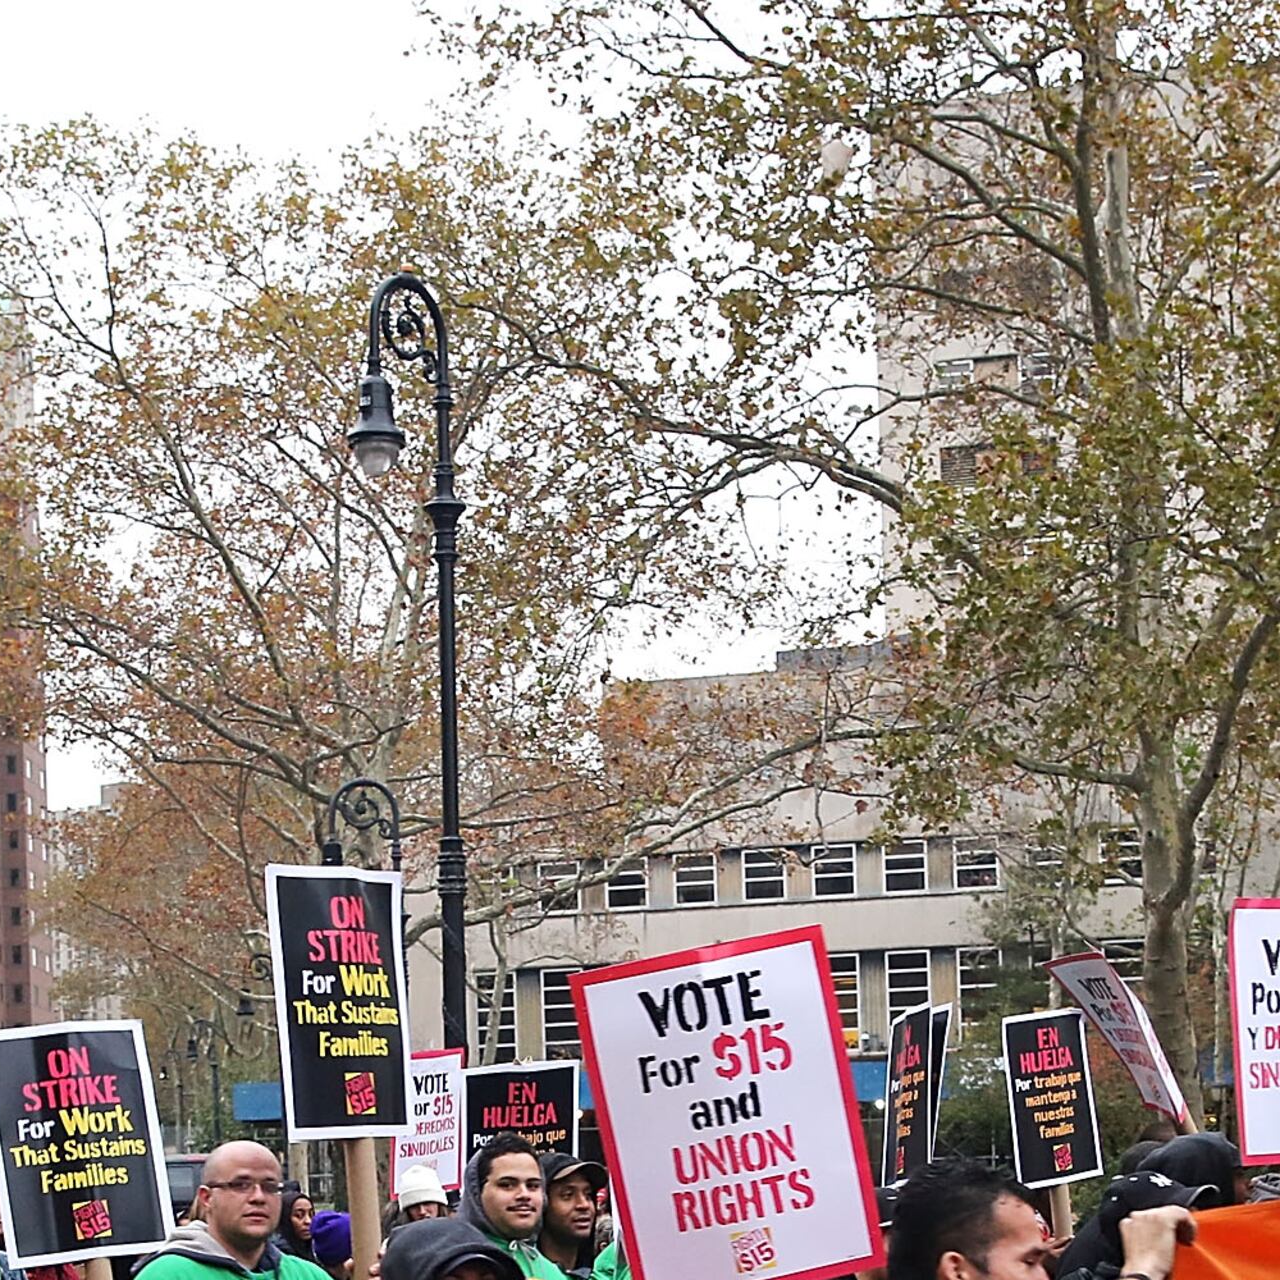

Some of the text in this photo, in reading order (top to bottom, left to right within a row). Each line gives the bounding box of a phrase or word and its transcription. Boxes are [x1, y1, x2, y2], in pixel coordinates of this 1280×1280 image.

[330, 896, 365, 929] ON
[307, 930, 383, 965] STRIKE
[302, 965, 391, 998] For Work
[293, 1000, 399, 1025] That Sustains
[638, 970, 770, 1038] VOTE
[319, 1031, 388, 1057] Families
[1037, 1027, 1059, 1050] EN
[1247, 1027, 1258, 1050] Y
[47, 1046, 90, 1079] ON
[638, 1022, 791, 1093] For $15
[1020, 1046, 1074, 1074] HUELGA
[22, 1075, 121, 1112] STRIKE
[413, 1073, 449, 1096] VOTE
[508, 1082, 536, 1104] EN
[1015, 1077, 1032, 1093] Por
[414, 1094, 453, 1116] or $15
[483, 1102, 557, 1129] HUELGA
[689, 1081, 762, 1130] and
[1033, 1106, 1074, 1123] nuestras
[17, 1104, 134, 1142] For Work
[546, 1129, 567, 1145] que
[10, 1136, 147, 1168] That Sustains
[399, 1136, 455, 1158] SINDICALES
[672, 1125, 796, 1184] UNION
[40, 1163, 129, 1194] Families
[672, 1168, 814, 1232] RIGHTS
[80, 1212, 112, 1238] $15
[739, 1241, 775, 1271] $15
